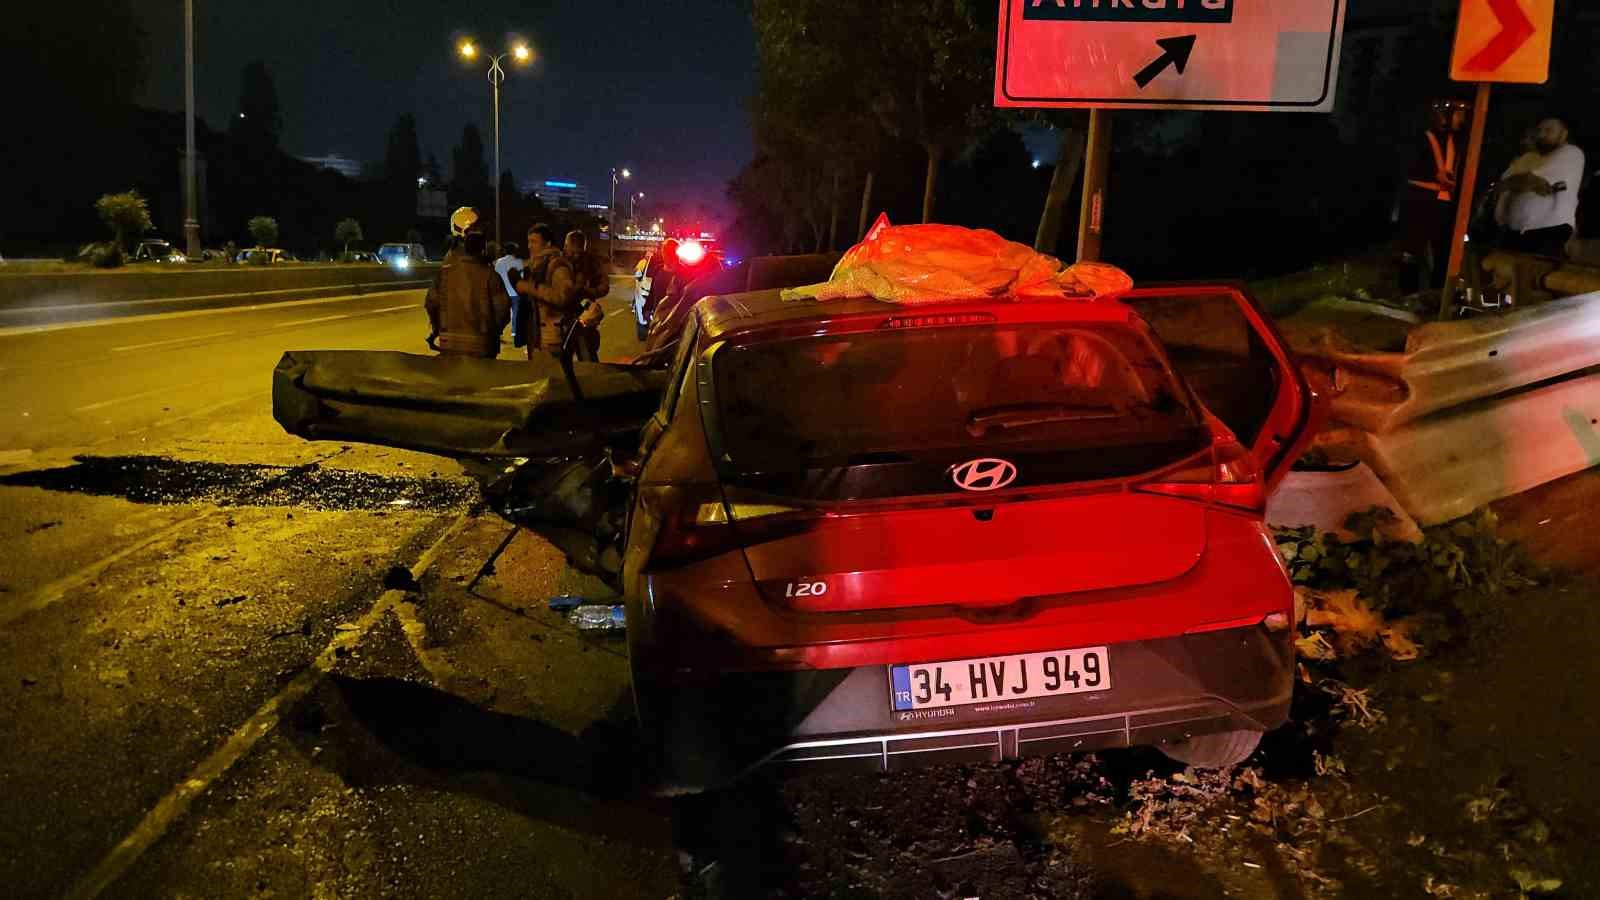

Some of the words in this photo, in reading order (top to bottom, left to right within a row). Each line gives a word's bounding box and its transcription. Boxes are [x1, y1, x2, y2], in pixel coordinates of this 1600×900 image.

[896, 691, 911, 702] TR
[913, 667, 952, 704] 34
[968, 659, 1028, 699] HVJ
[1042, 652, 1101, 691] 949
[914, 707, 955, 720] HYUNDAI
